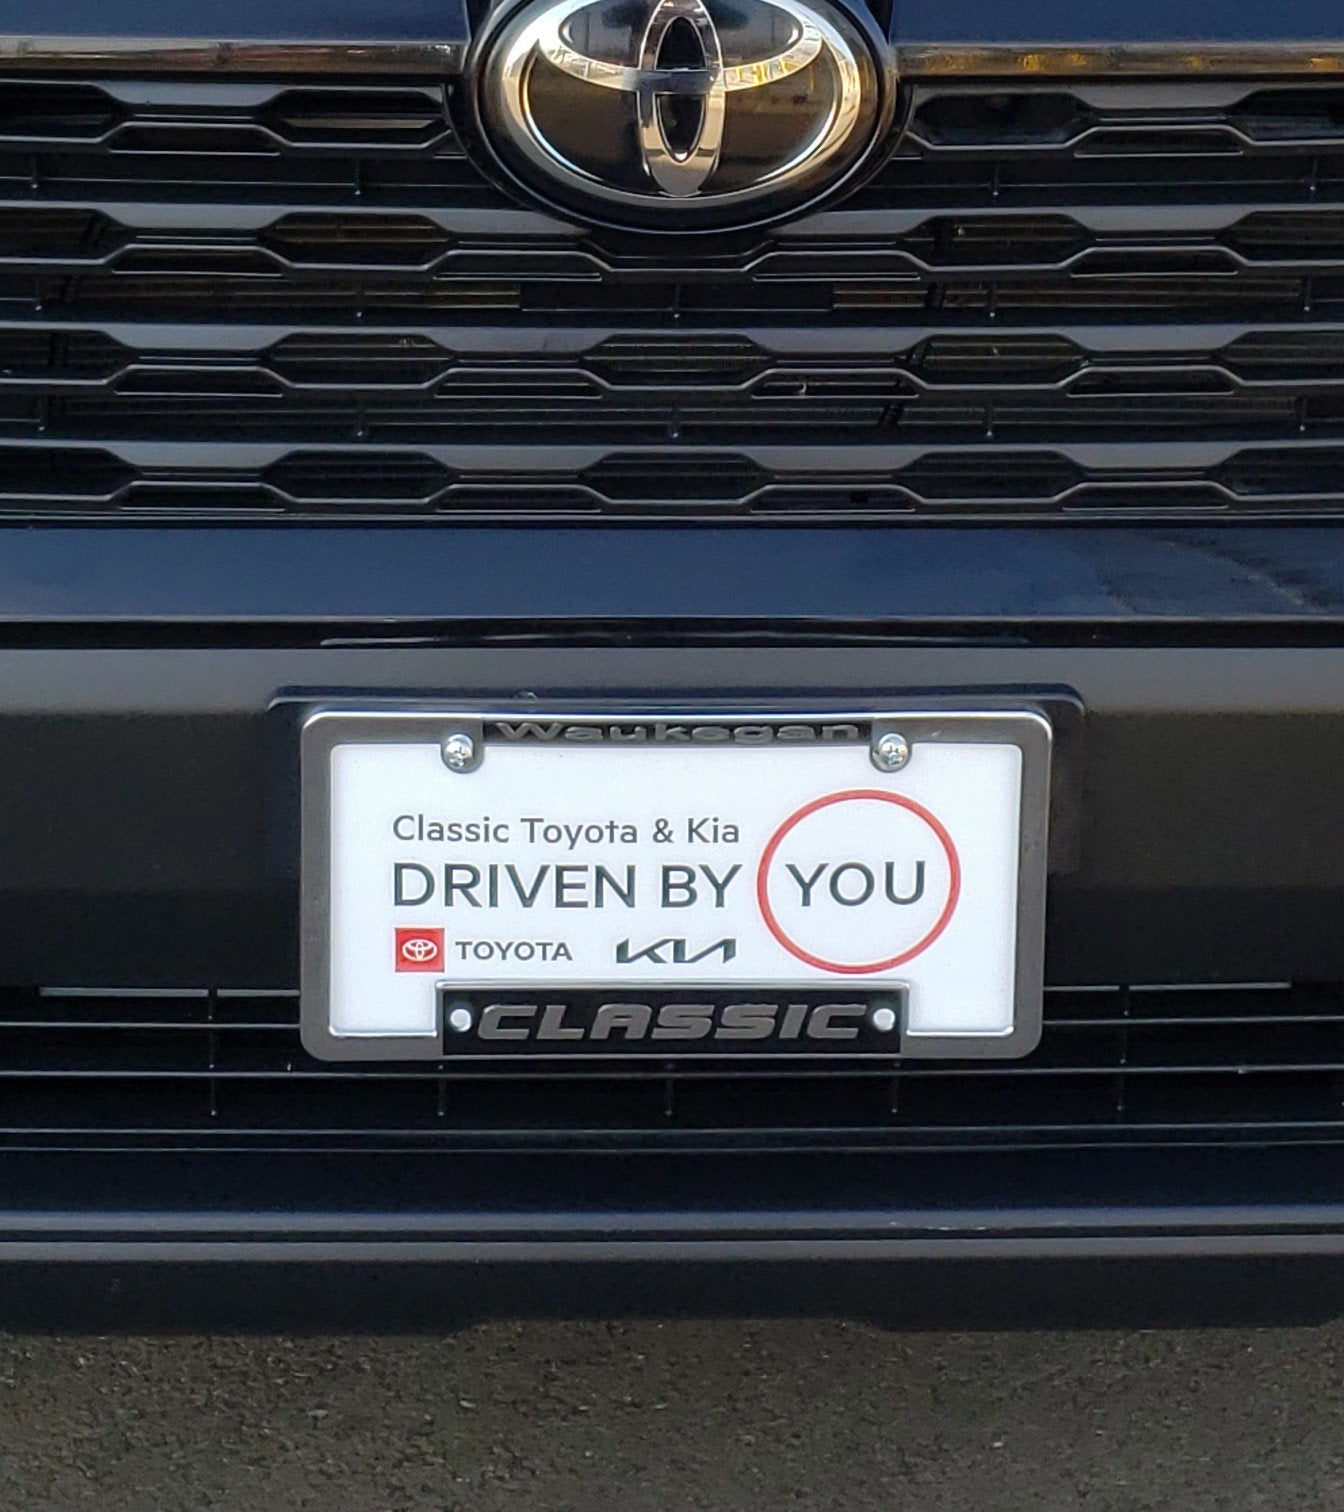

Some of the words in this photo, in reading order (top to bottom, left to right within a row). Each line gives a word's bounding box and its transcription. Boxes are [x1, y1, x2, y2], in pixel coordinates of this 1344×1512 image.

[392, 814, 509, 842] Classic
[520, 818, 638, 850] Toyota
[652, 818, 674, 843] &
[687, 817, 740, 843] Kia
[394, 862, 636, 908] DRIVEN
[661, 864, 743, 908] BY
[786, 861, 926, 906] YOU
[456, 941, 573, 961] TOYOTA
[478, 1004, 865, 1041] CLASSIC
